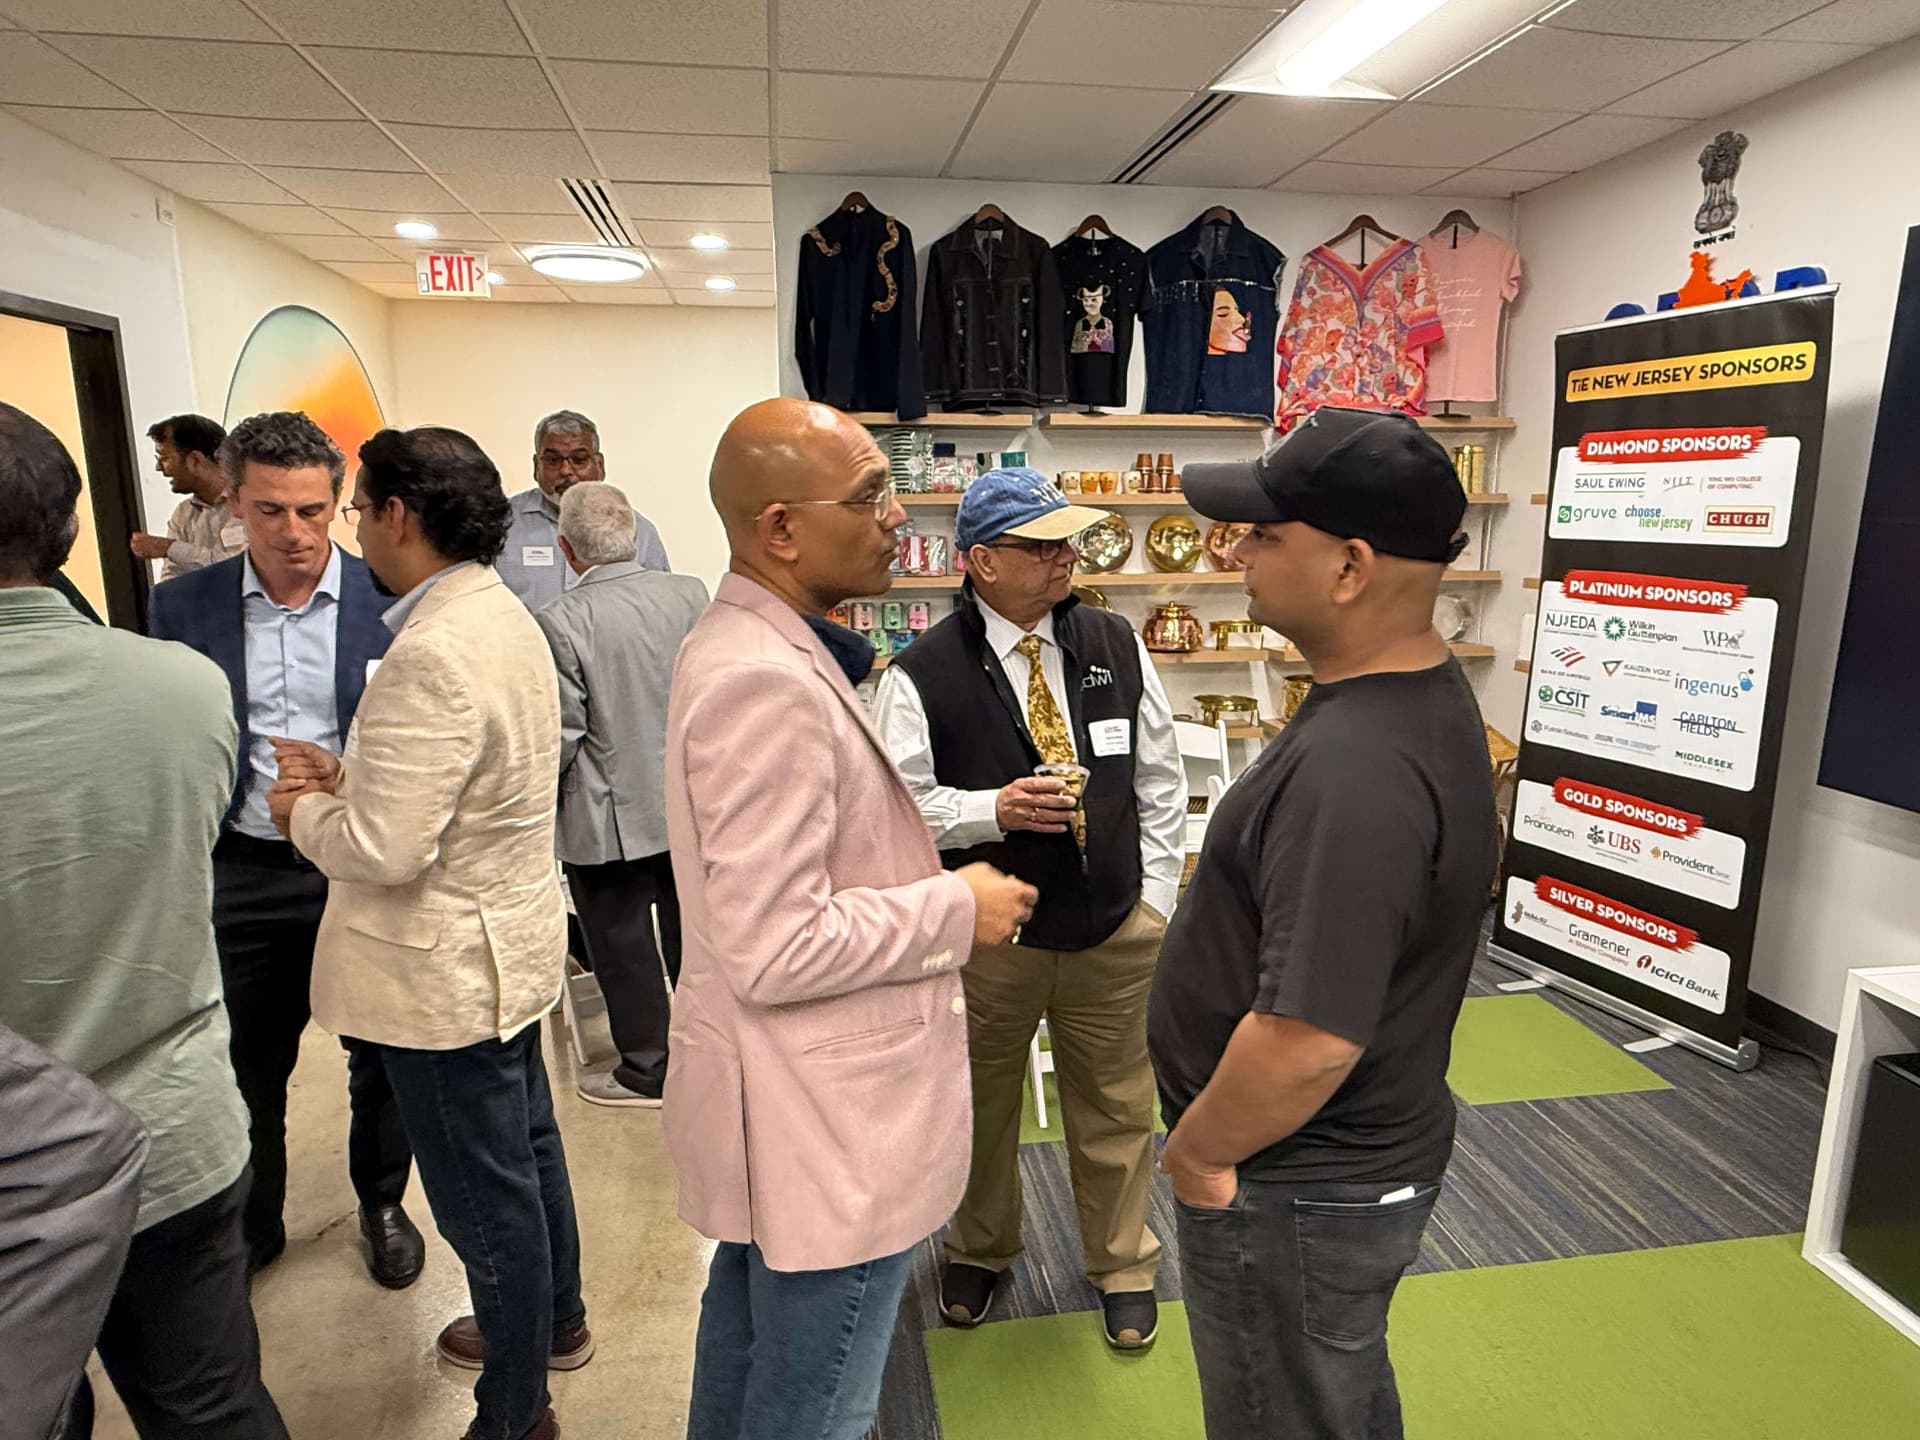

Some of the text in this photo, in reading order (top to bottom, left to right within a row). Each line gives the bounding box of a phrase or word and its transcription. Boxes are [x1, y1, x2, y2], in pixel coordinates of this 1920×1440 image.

[429, 255, 475, 292] EXIT
[1592, 373, 1629, 391] NEW
[1632, 365, 1696, 387] JERSEY
[1699, 353, 1807, 380] SPONSORS
[1586, 434, 1752, 456] DIAMOND SPONSORS
[1574, 477, 1645, 489] SAUL EWING
[1573, 507, 1617, 522] gruve
[1624, 504, 1662, 518] choose
[1708, 513, 1768, 526] CHUGH
[1569, 580, 1733, 607] PLATINUM SPONSORS
[1674, 673, 1739, 698] ingenus
[1555, 689, 1590, 709] CSIT
[1679, 722, 1720, 739] FIELDS
[1680, 711, 1737, 731] CARLTON
[1674, 750, 1734, 770] MIDDLESEX
[1563, 788, 1687, 833] GOLD SPONSORS
[1607, 830, 1641, 855] UBS
[1662, 850, 1714, 875] Provident
[1550, 887, 1594, 912] SILVER
[1596, 904, 1678, 944] SPONSORS
[1568, 923, 1630, 957] Gramener
[1650, 965, 1720, 1000] ICICI Bank
